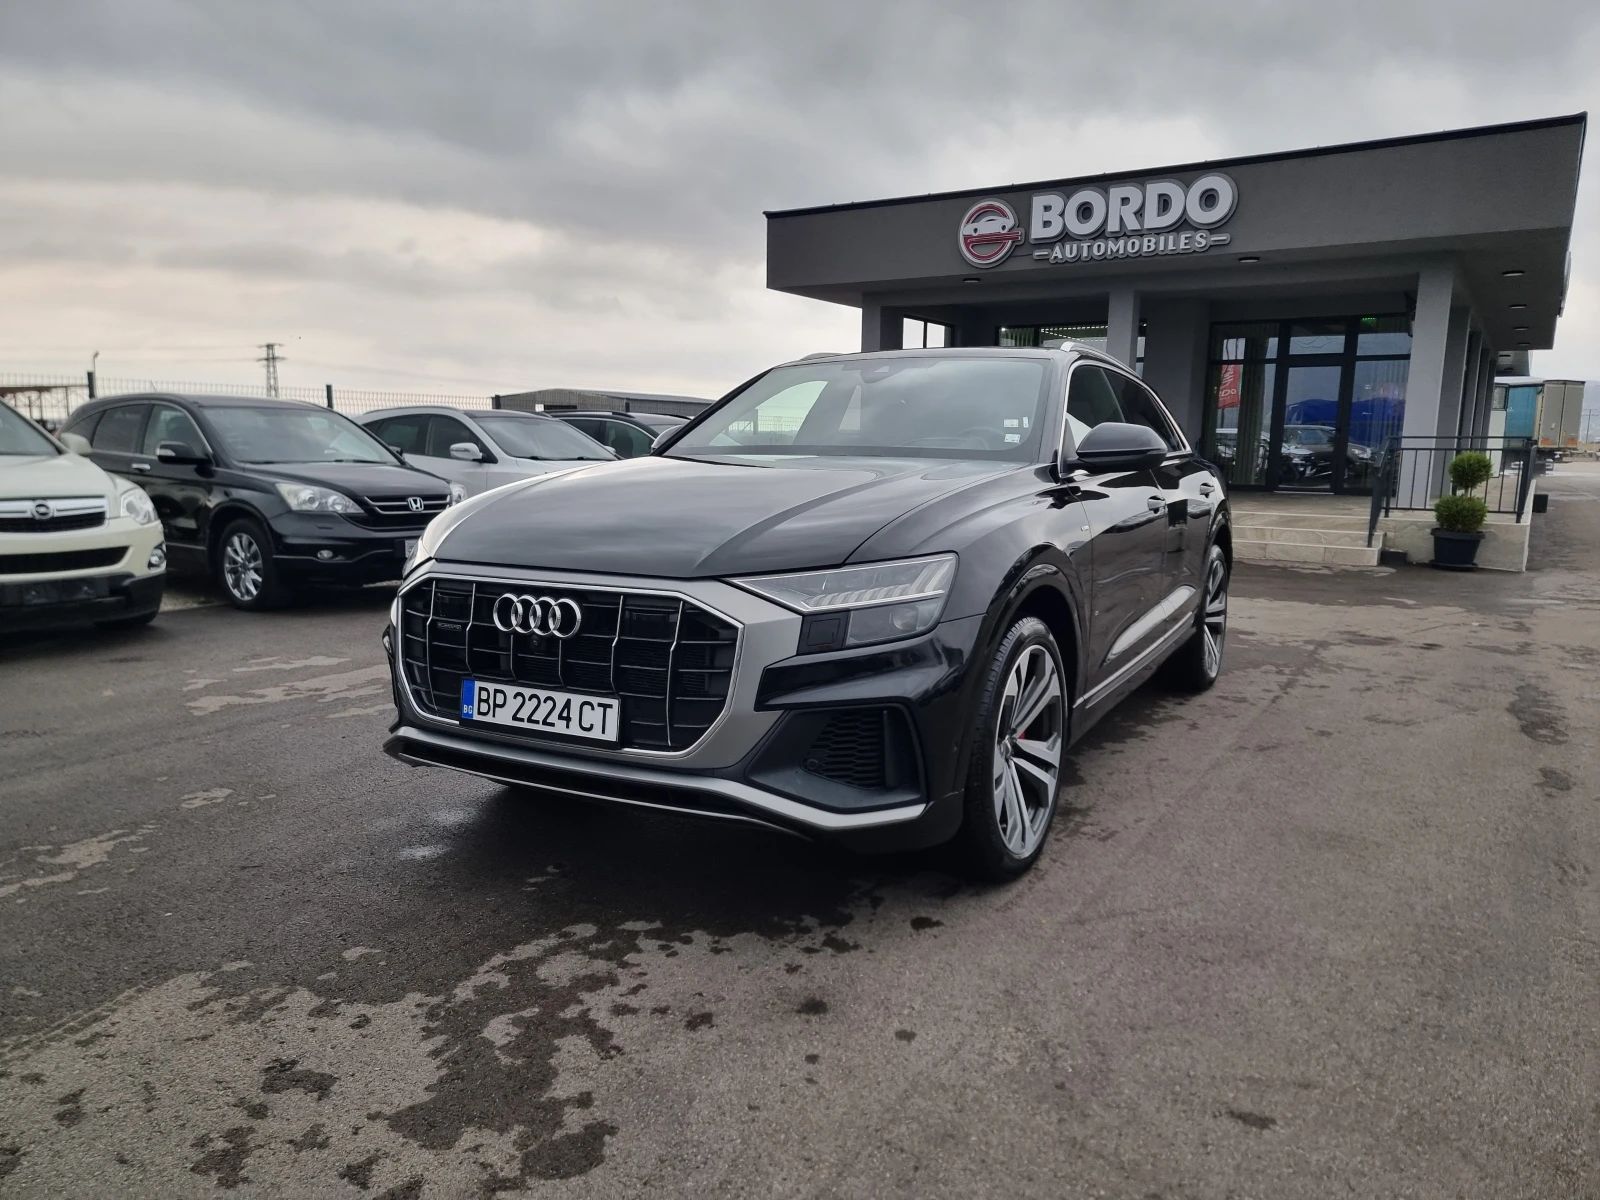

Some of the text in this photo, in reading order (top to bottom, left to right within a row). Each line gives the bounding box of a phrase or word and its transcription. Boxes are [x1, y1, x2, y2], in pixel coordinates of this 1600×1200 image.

[1031, 176, 1234, 240] BORDO
[1051, 232, 1207, 259] AUTOMOBILES
[463, 704, 473, 714] BG
[477, 686, 613, 735] BP 2224 CT
